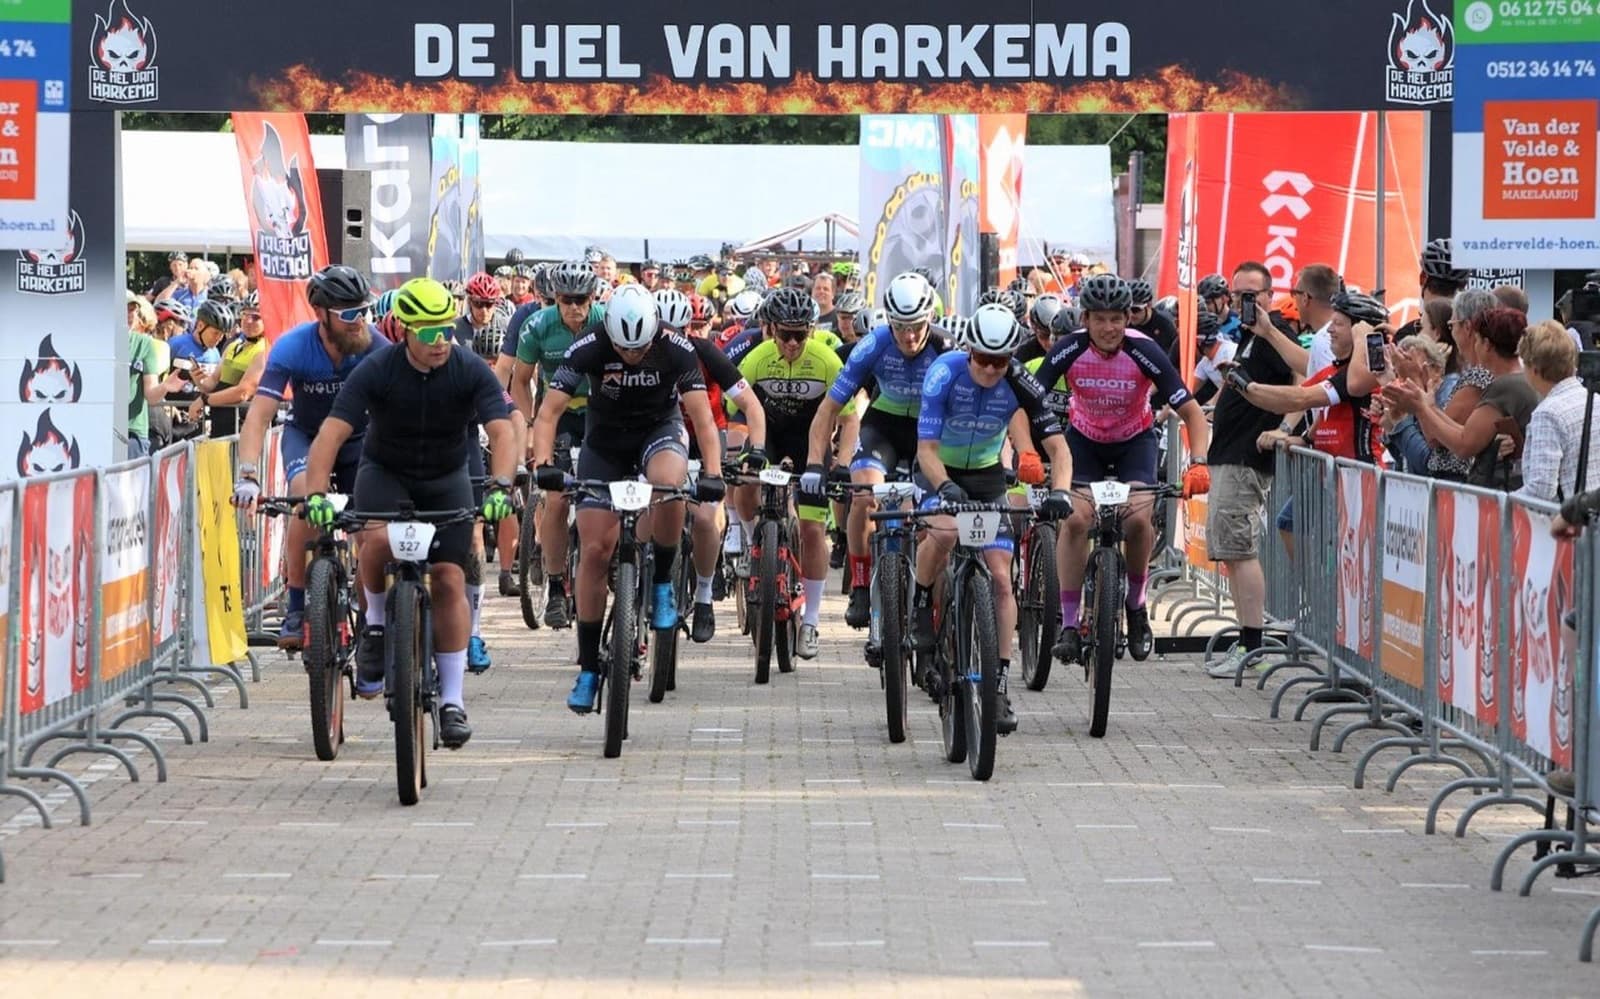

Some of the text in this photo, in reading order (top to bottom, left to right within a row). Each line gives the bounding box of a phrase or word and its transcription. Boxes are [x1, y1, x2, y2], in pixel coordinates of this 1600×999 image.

[1499, 0, 1593, 17] 06 12 75 04
[14, 39, 37, 57] 74
[414, 22, 1131, 78] DE HEL VAN HARKEMA
[1486, 60, 1597, 78] 0512 36 14 74
[93, 70, 154, 85] DE HEL VAN
[1391, 70, 1453, 85] DE HEL VAN
[93, 83, 155, 99] HARKEMA
[1390, 82, 1453, 99] HARKEMA
[2, 119, 19, 137] &
[1502, 118, 1580, 135] Van der
[1502, 139, 1580, 157] Velde &
[1502, 162, 1579, 185] Hoen
[363, 113, 411, 273] kar
[1502, 189, 1578, 201] MAKELAARDIJ
[1462, 237, 1600, 250] vandervelde-hoen.
[20, 263, 83, 277] DE HEL VAN
[20, 275, 83, 293] HARKEMA
[1468, 277, 1522, 291] ARKEMA
[622, 371, 661, 387] intal
[1075, 377, 1137, 390] GROOTS
[969, 529, 986, 540] 311
[398, 541, 421, 552] 327
